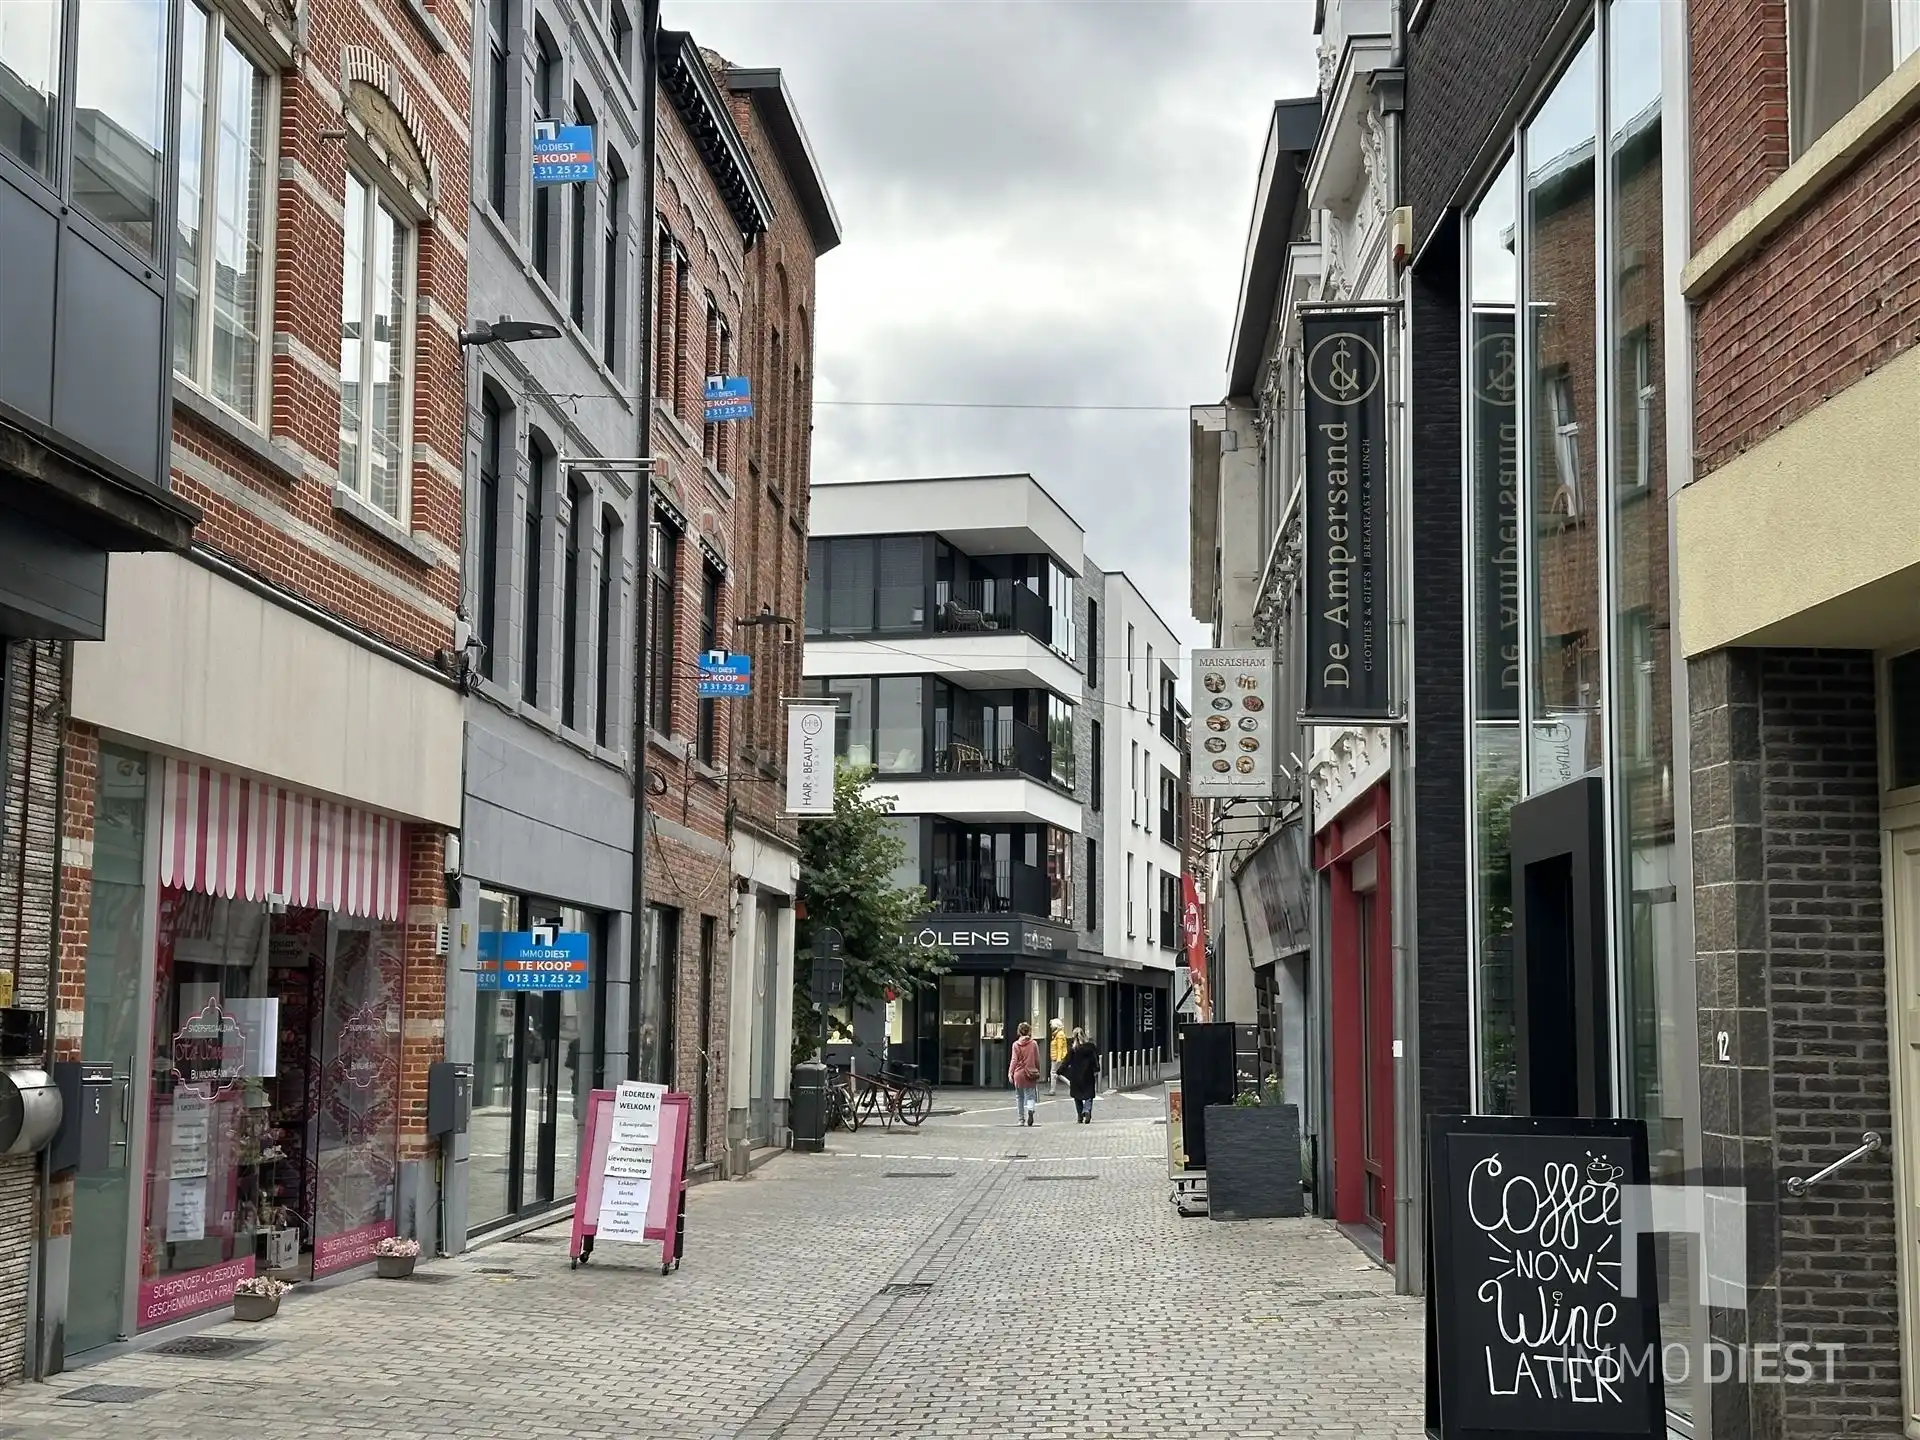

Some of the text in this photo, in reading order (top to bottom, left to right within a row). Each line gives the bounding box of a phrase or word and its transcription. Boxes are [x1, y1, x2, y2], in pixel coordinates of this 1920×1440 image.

[532, 153, 577, 164] E KOOP
[540, 166, 553, 175] 31
[557, 165, 571, 174] 25
[574, 164, 588, 173] 22
[714, 397, 740, 407] KOOP
[737, 405, 747, 413] 22
[1362, 438, 1371, 477] LUNCH
[1363, 494, 1372, 558] BREAKFAST
[1319, 421, 1356, 688] De Ampersand
[1363, 571, 1372, 603] GIFTS
[1364, 619, 1372, 672] CLOTHES
[1199, 658, 1266, 667] MAISALSHAM
[698, 682, 708, 690] 13
[713, 674, 738, 682] KOOP
[803, 735, 813, 773] BEAUTY
[802, 782, 812, 806] HAIR
[518, 960, 572, 971] TE KOOP
[545, 950, 570, 959] DIEST
[508, 973, 581, 984] 013 31 25 22
[1143, 992, 1152, 1032] TRIXXO
[1717, 1031, 1730, 1061] 12
[620, 1103, 651, 1111] WELKOM
[622, 1090, 655, 1099] IEDEREEN
[628, 1166, 647, 1174] Snoep
[1469, 1153, 1622, 1249] Coffee
[1516, 1249, 1593, 1284] NOW
[153, 1263, 245, 1299] SCHEPSNOEP CUBERDONS
[147, 1288, 213, 1319] GESCHENKMANDEN
[1478, 1279, 1617, 1351] Wine
[1485, 1345, 1623, 1403] LATER
